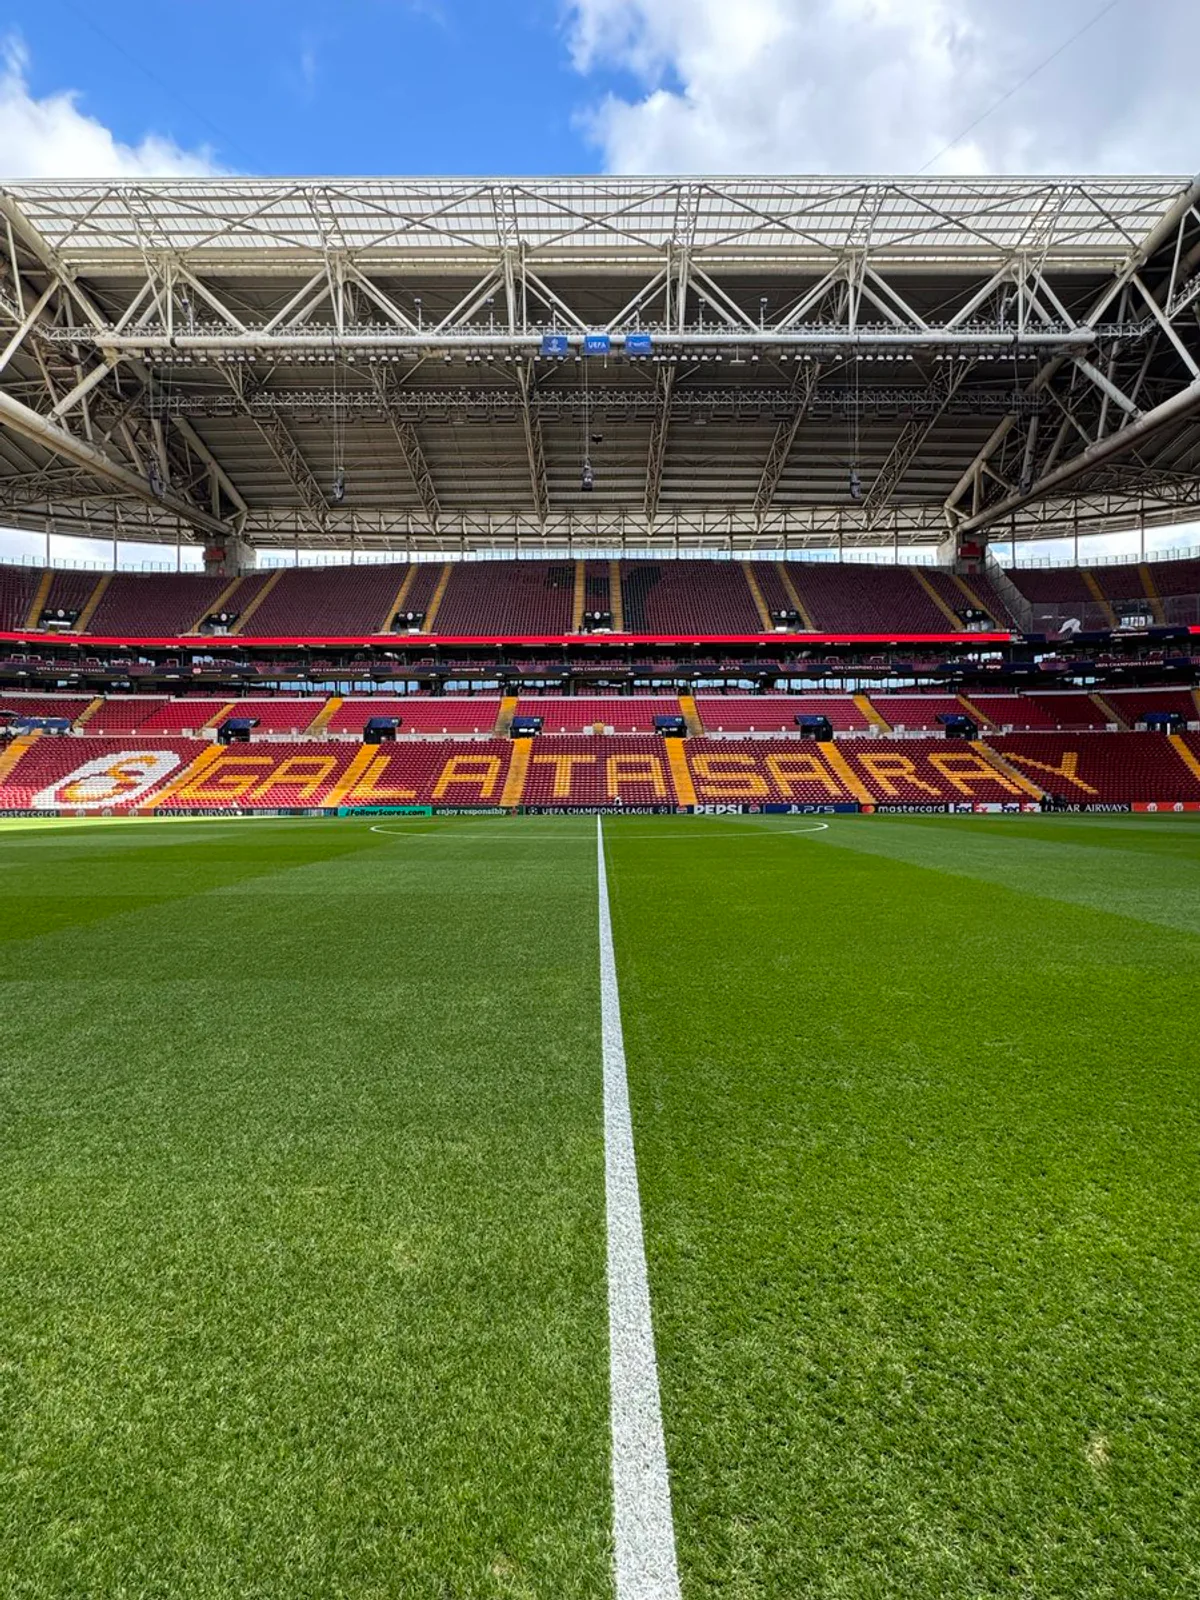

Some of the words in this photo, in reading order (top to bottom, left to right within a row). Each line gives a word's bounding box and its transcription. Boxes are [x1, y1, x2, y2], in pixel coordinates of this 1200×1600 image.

[587, 341, 606, 349] UEFA
[156, 808, 193, 817] QATAR
[436, 807, 459, 816] enjoy
[460, 807, 508, 816] responsibly
[542, 806, 565, 815] UEFA
[566, 806, 619, 815] CHAMPIONS
[621, 806, 653, 815] LEAGUE
[694, 804, 743, 815] PEPSI
[803, 805, 835, 814] PS5
[878, 803, 946, 813] mastercard
[1083, 803, 1130, 813] AIRWAYS
[0, 809, 57, 818] astercard
